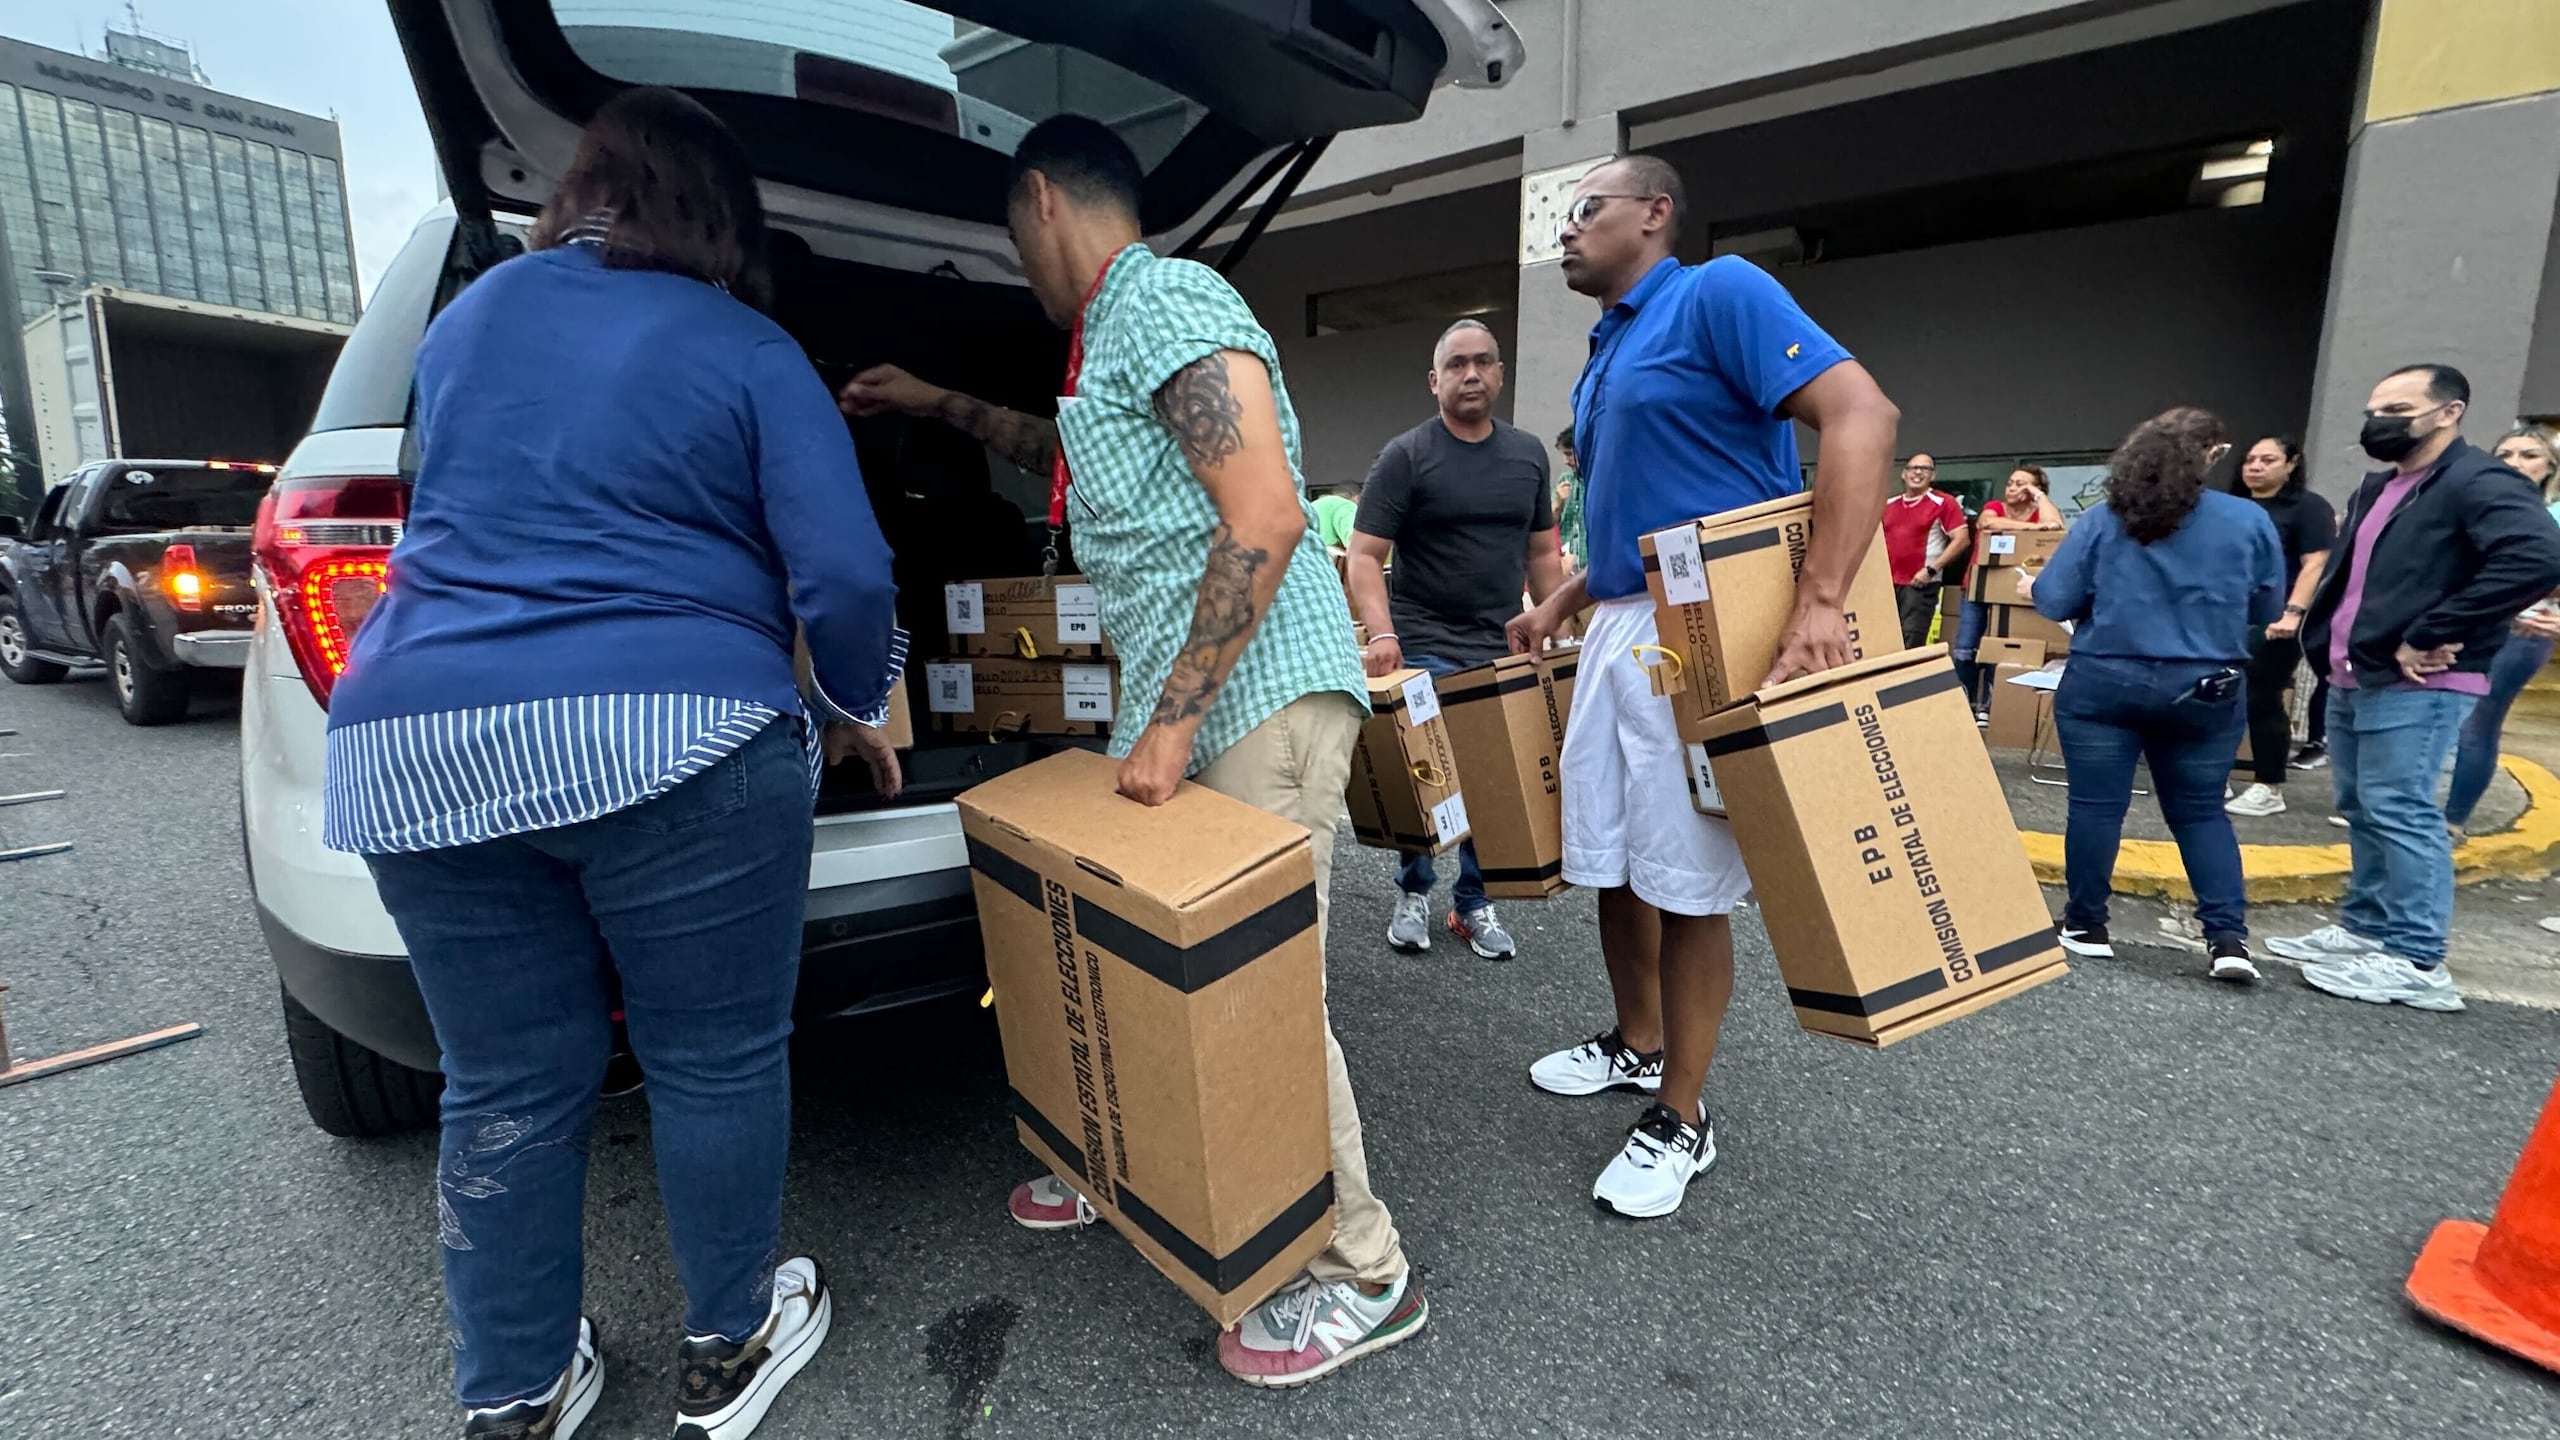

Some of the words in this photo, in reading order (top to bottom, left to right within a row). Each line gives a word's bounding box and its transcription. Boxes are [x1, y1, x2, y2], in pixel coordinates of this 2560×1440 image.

[37, 61, 154, 102] MUNICIPIO
[164, 92, 193, 112] DE
[203, 103, 245, 124] SAN
[248, 114, 296, 137] JUAN
[1542, 676, 1563, 741] ELECCIONES
[1701, 765, 1711, 788] EPB
[1854, 703, 1906, 801] ELECCIONES
[1890, 802, 1915, 828] DE
[1901, 827, 1941, 898] ESTATAL
[1046, 878, 1083, 1008] ELECCIONES
[1926, 899, 1974, 984] COMISION
[1064, 1003, 1088, 1038] DE
[1085, 950, 1109, 1040] ELECTRONICO
[1070, 1037, 1098, 1118] ESTATAL
[1108, 1106, 1123, 1128] DE
[1081, 1110, 1114, 1206] COMISION
